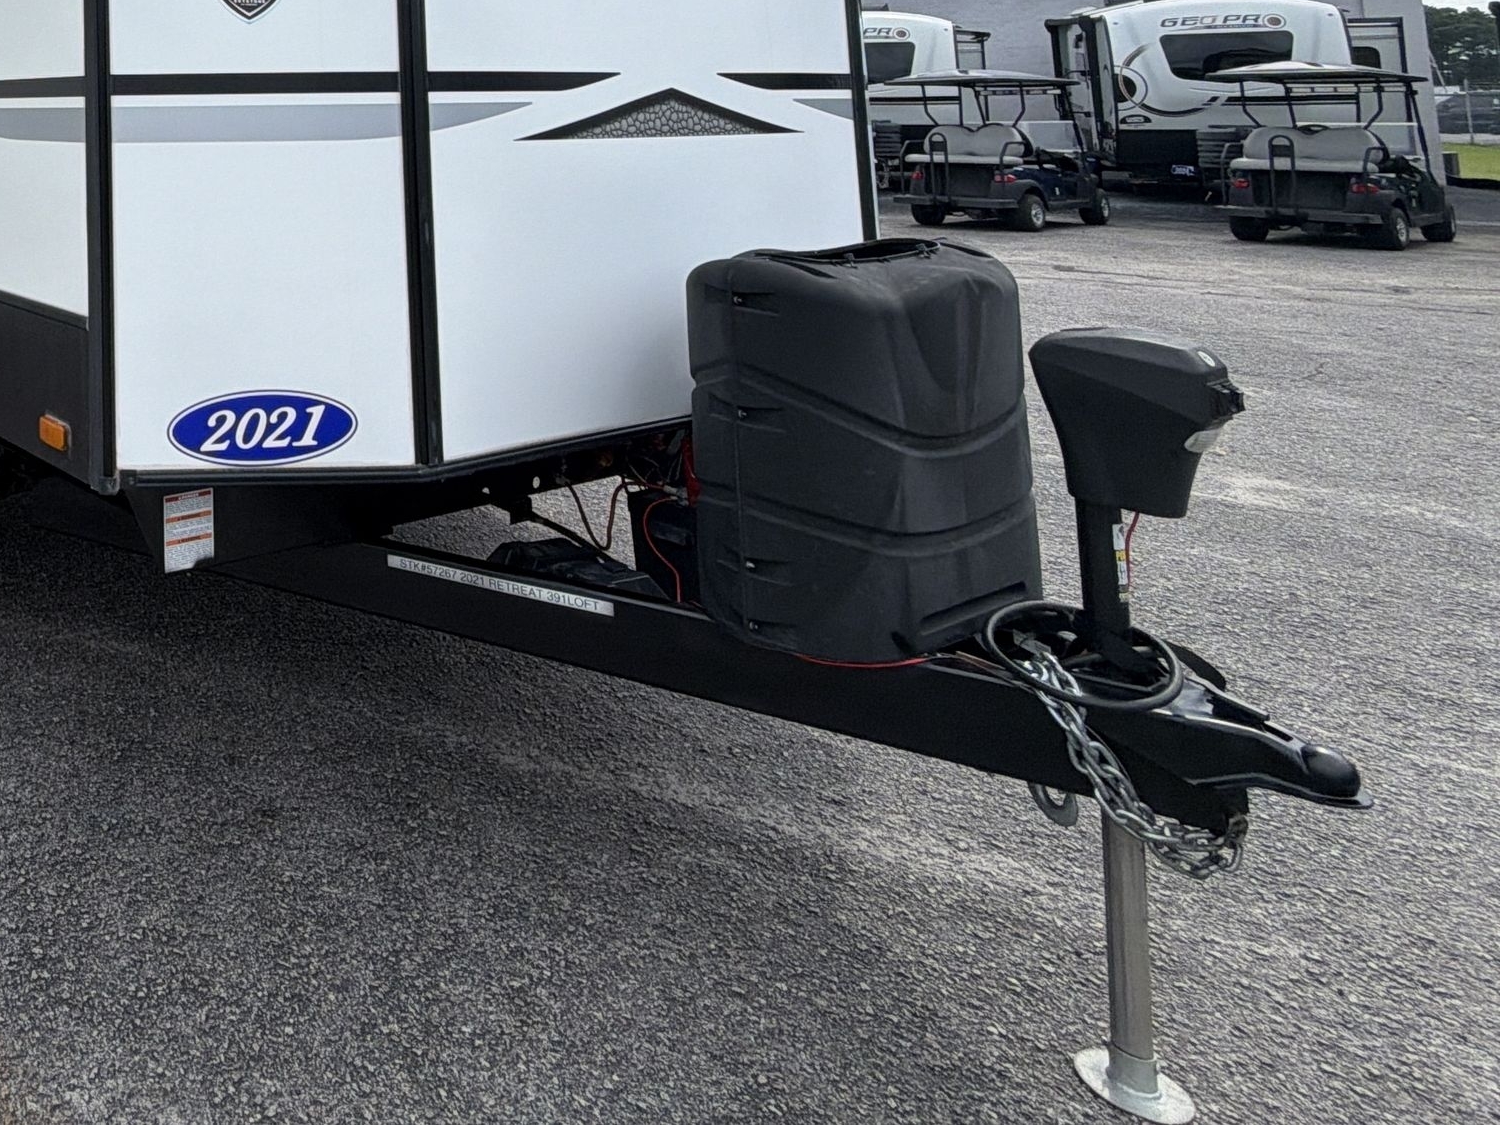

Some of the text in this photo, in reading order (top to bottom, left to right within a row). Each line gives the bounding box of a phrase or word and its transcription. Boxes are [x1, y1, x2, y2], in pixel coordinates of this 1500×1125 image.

[1160, 15, 1217, 27] GEO
[200, 404, 326, 453] 2021
[399, 558, 599, 611] STK#57267 2021 RETREAT 391LOFT
